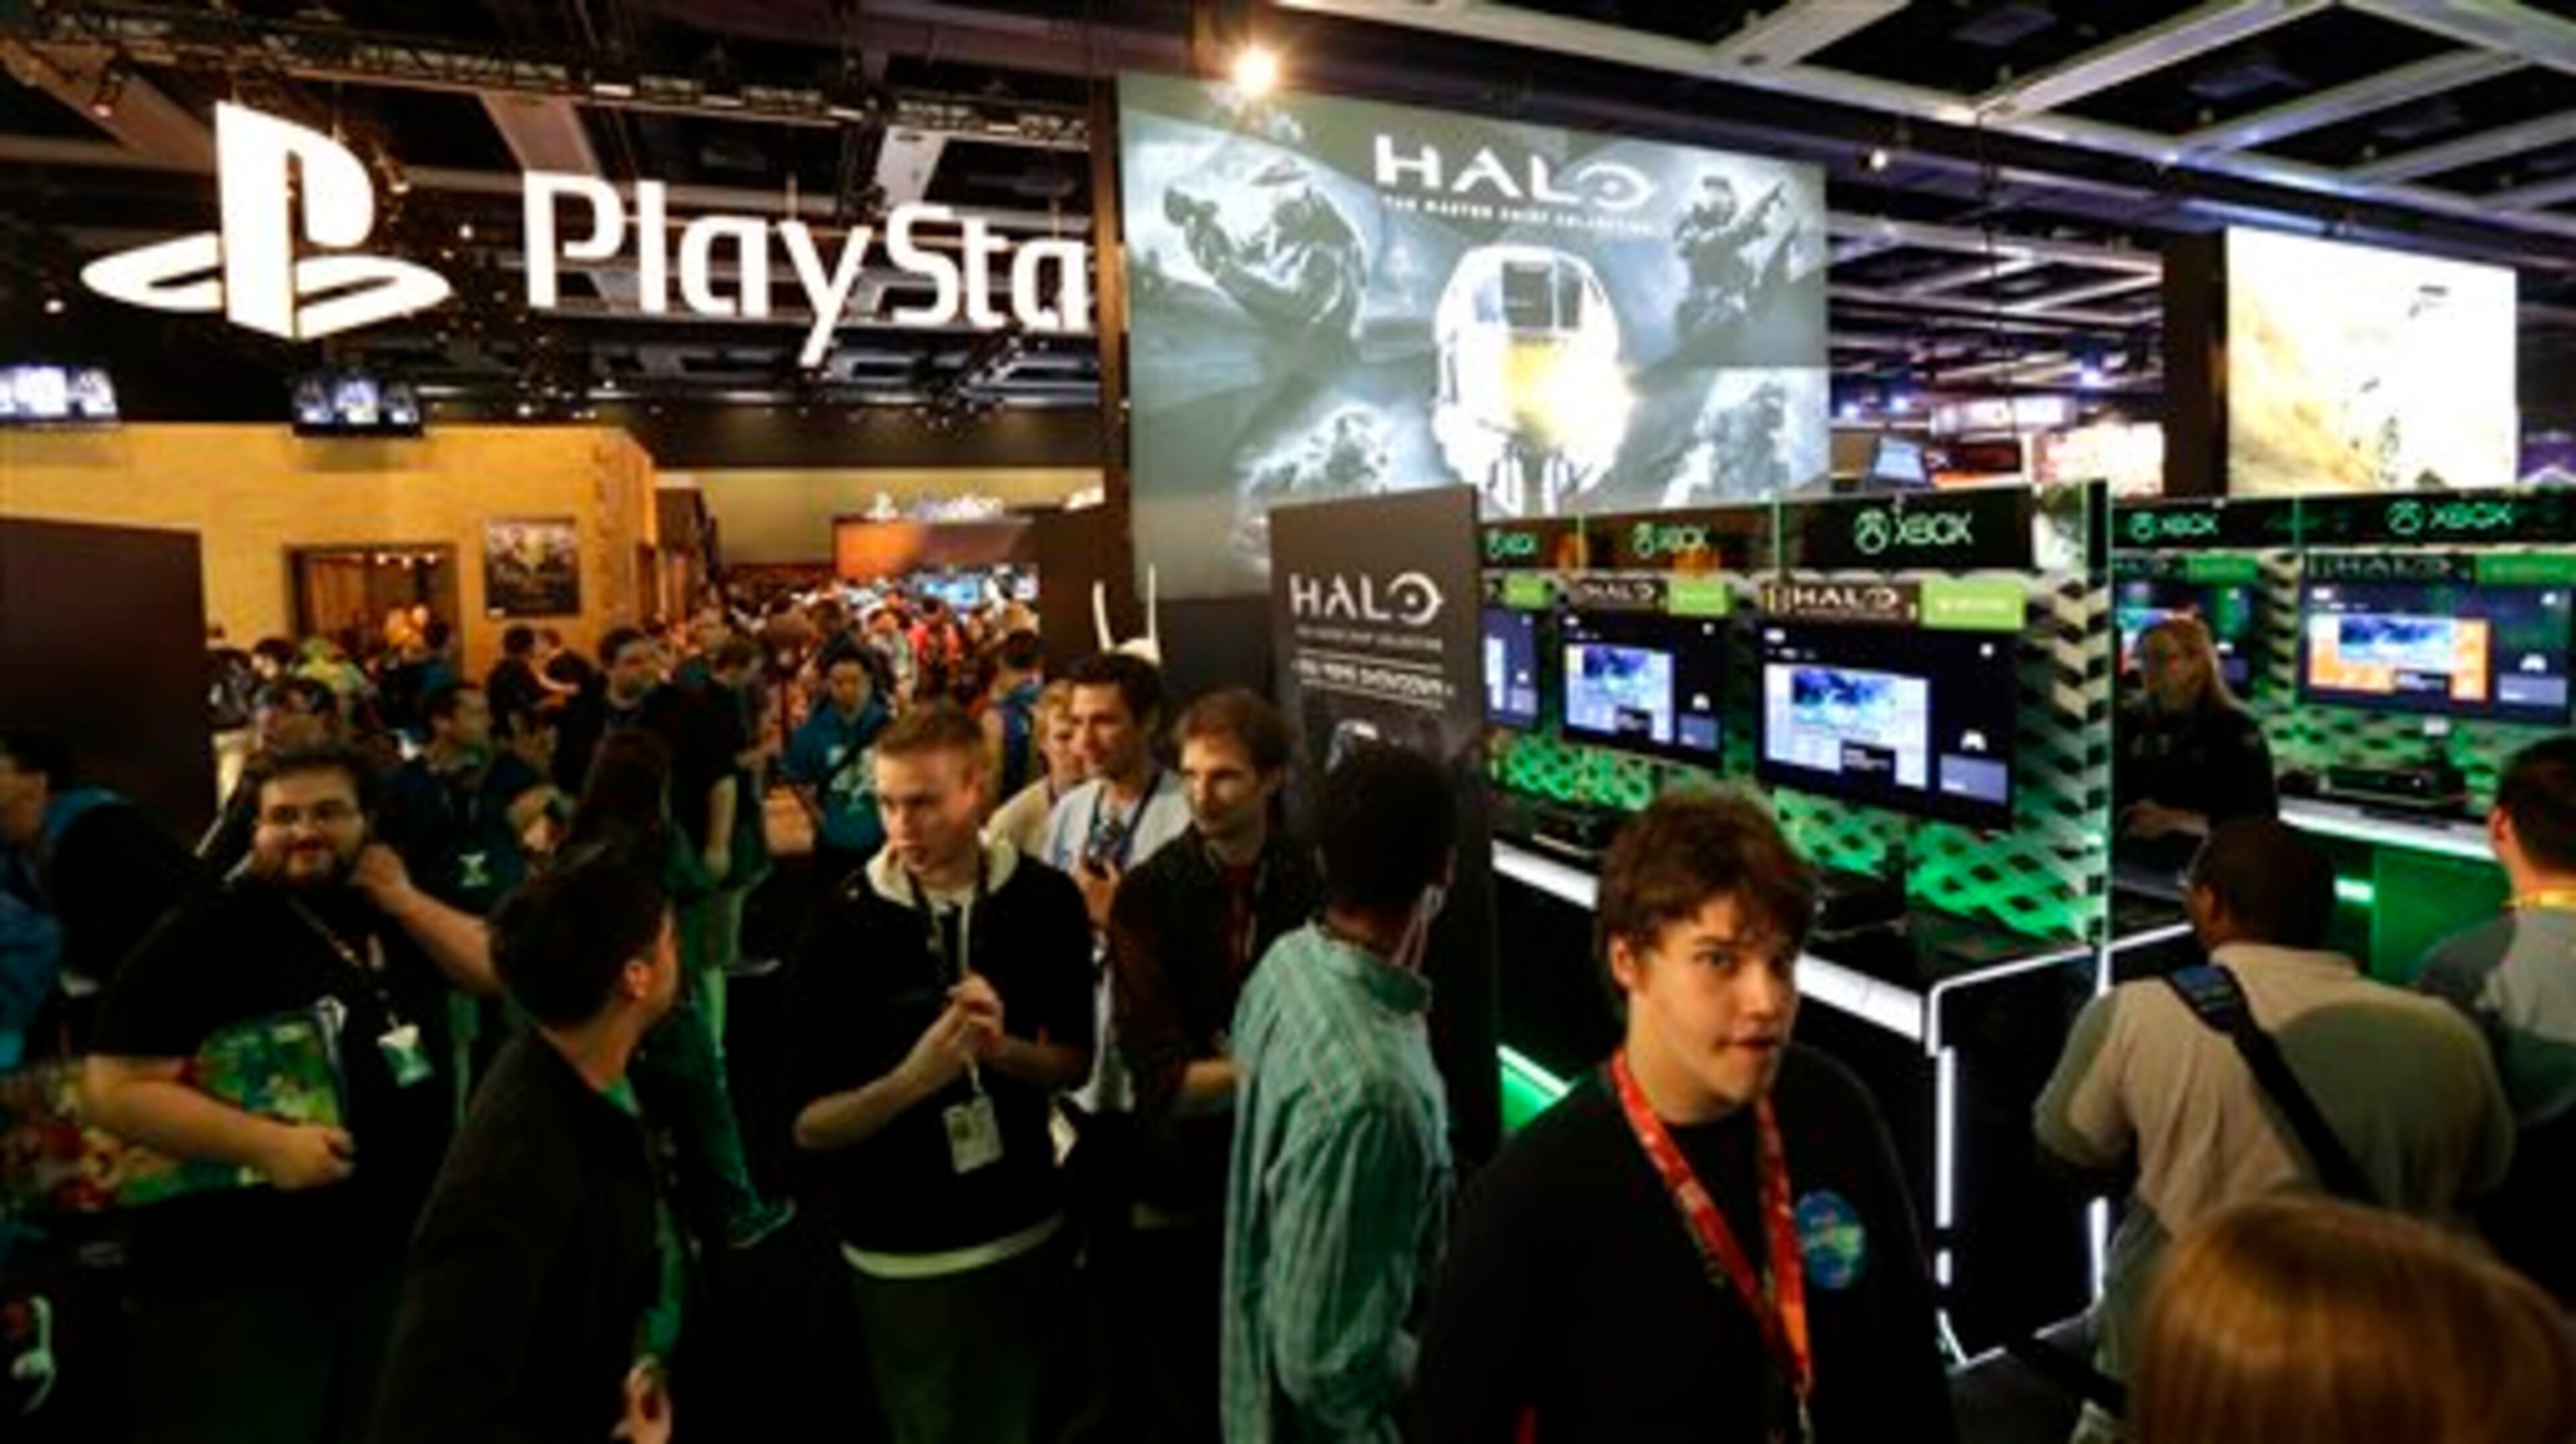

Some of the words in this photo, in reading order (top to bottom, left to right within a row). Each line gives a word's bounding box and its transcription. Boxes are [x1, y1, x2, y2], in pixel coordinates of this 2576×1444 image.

[1374, 135, 1656, 209] HALO
[523, 170, 1092, 367] PlaySta
[1894, 512, 1973, 545] XBOX
[2161, 512, 2219, 537] XBOX
[2428, 502, 2512, 530] XBOX
[1289, 572, 1444, 625] HALO
[1792, 587, 1898, 609] HALO
